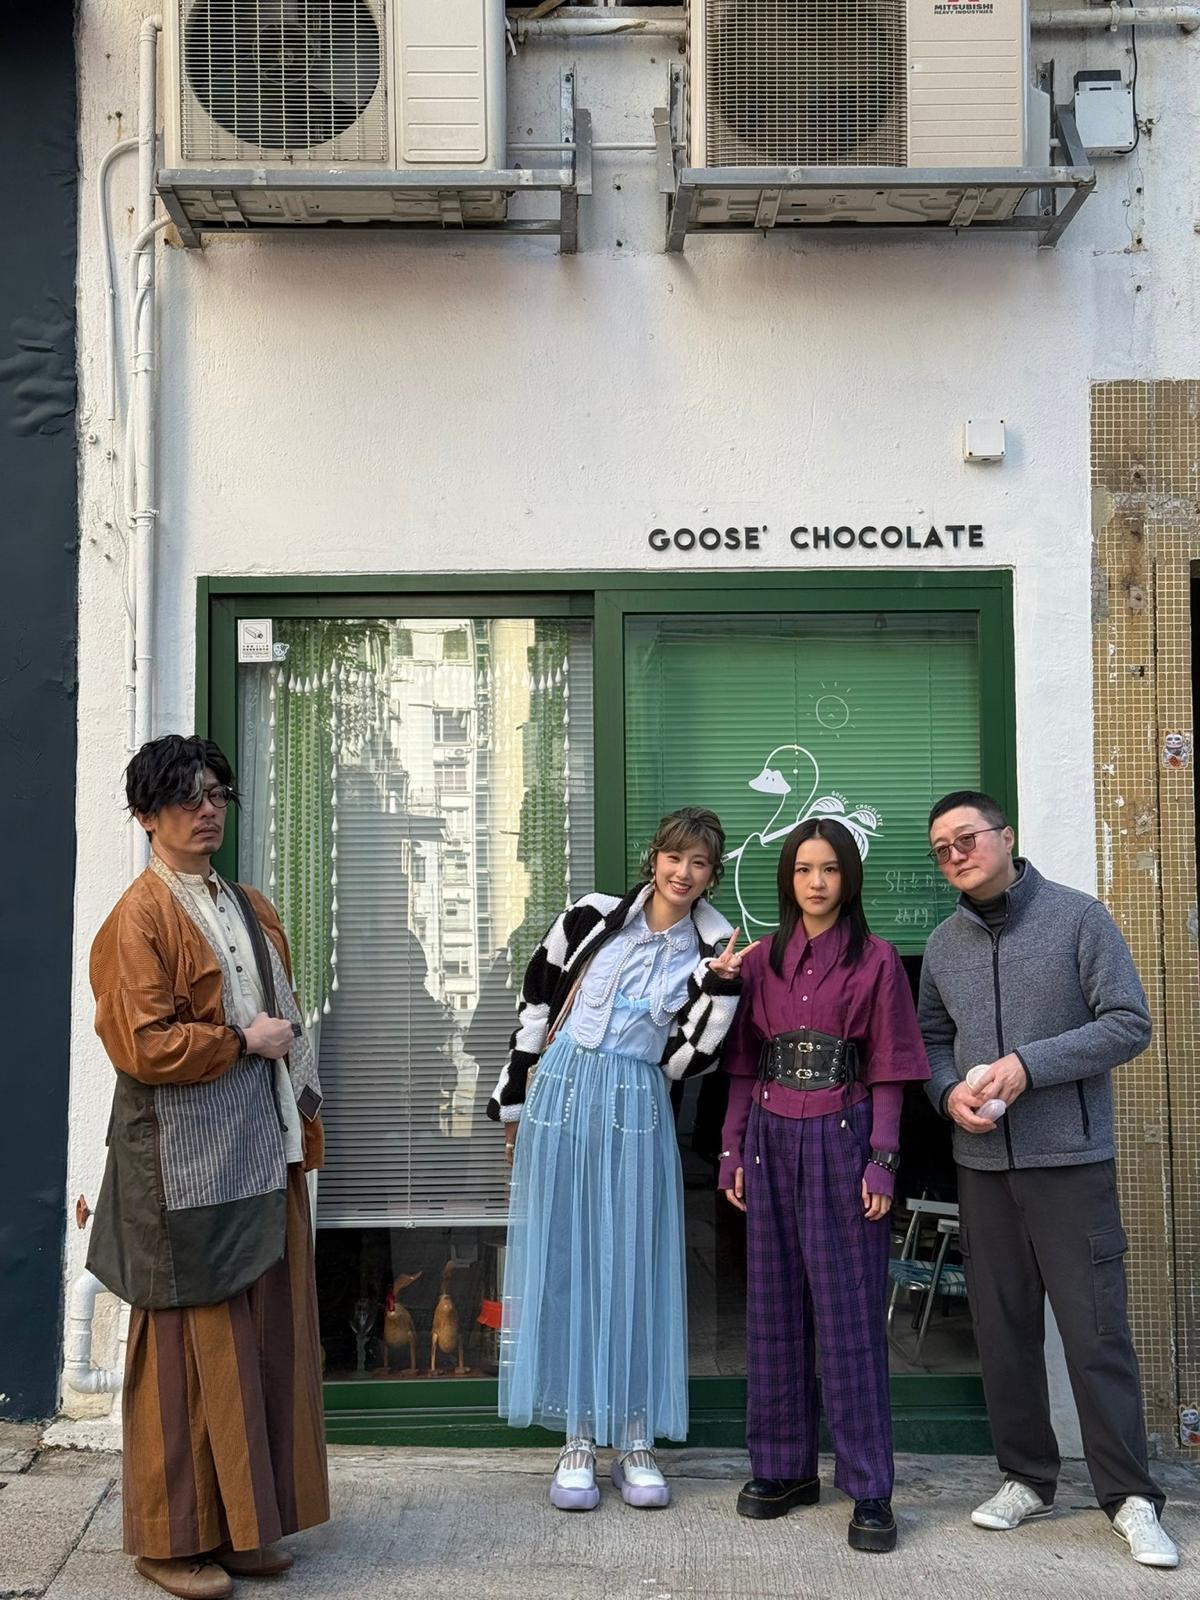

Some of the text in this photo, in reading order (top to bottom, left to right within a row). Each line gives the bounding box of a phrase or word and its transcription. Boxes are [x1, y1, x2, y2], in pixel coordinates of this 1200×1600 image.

[648, 525, 983, 551] GOOSE' CHOCOLATE
[855, 804, 883, 826] CHOCOLATE
